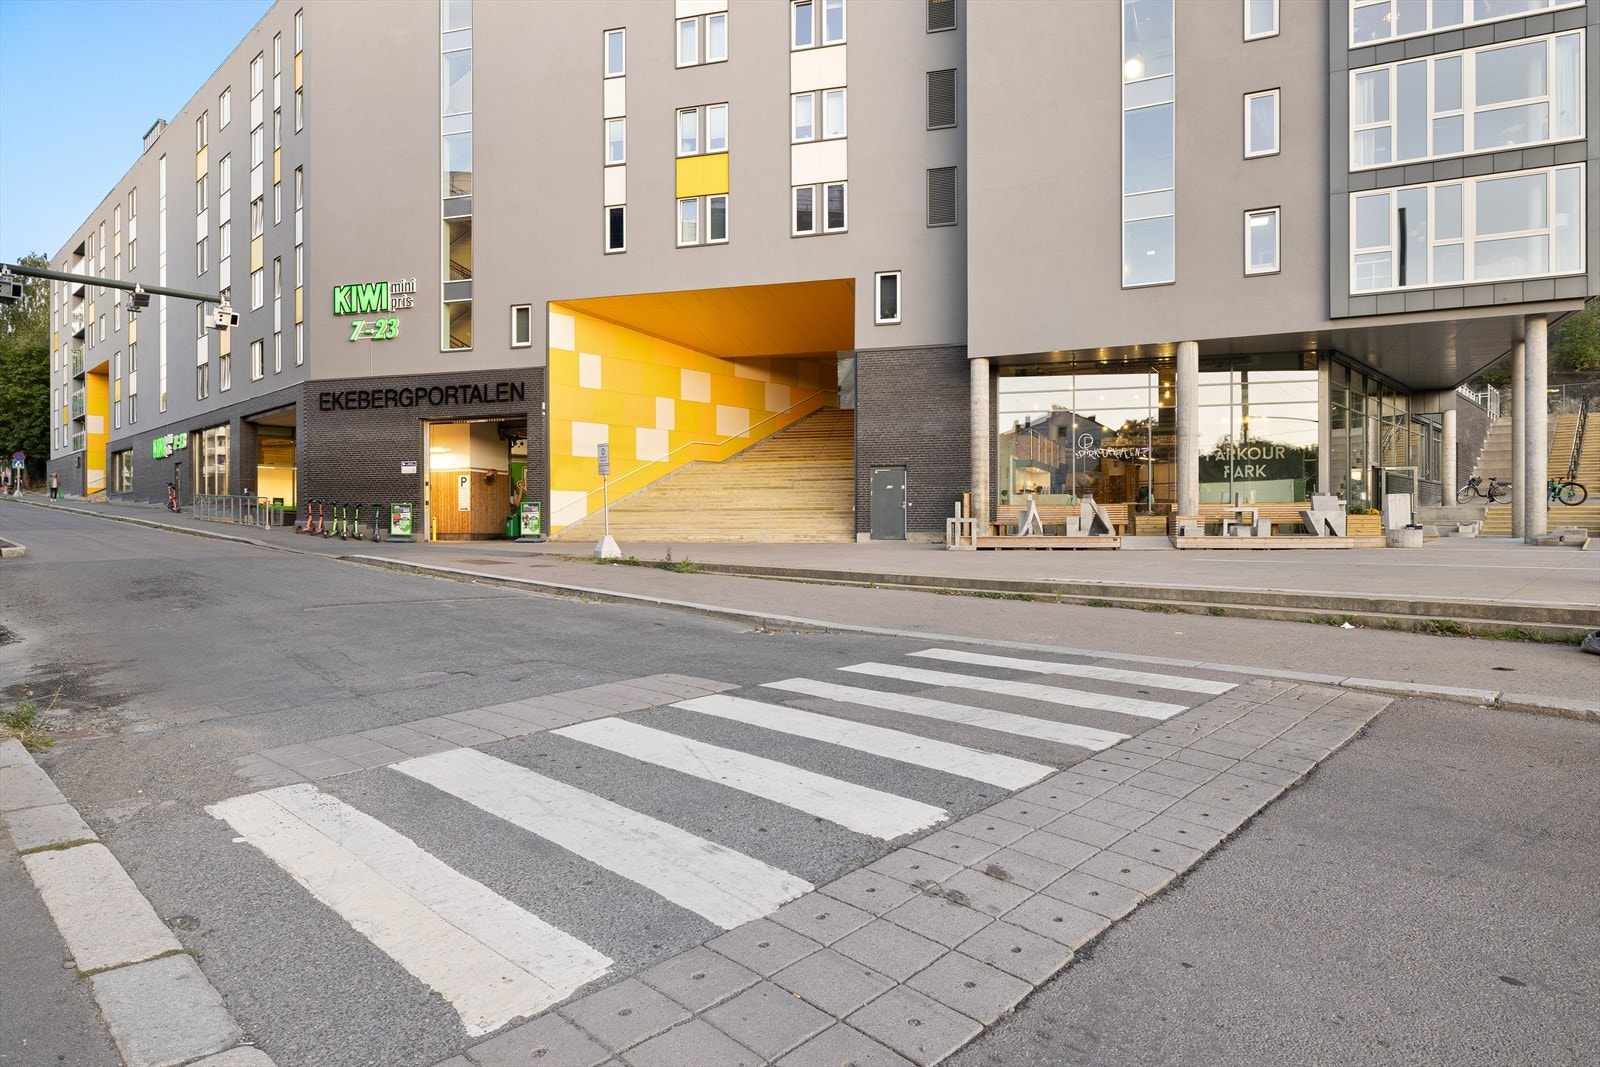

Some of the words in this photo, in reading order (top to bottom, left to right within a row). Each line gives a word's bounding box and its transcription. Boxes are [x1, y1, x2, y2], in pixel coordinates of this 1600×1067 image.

[333, 281, 390, 315] KIWI
[390, 278, 416, 294] mini
[390, 295, 414, 311] pris
[319, 381, 525, 411] EKEBERGPORTALEN
[461, 477, 468, 487] P
